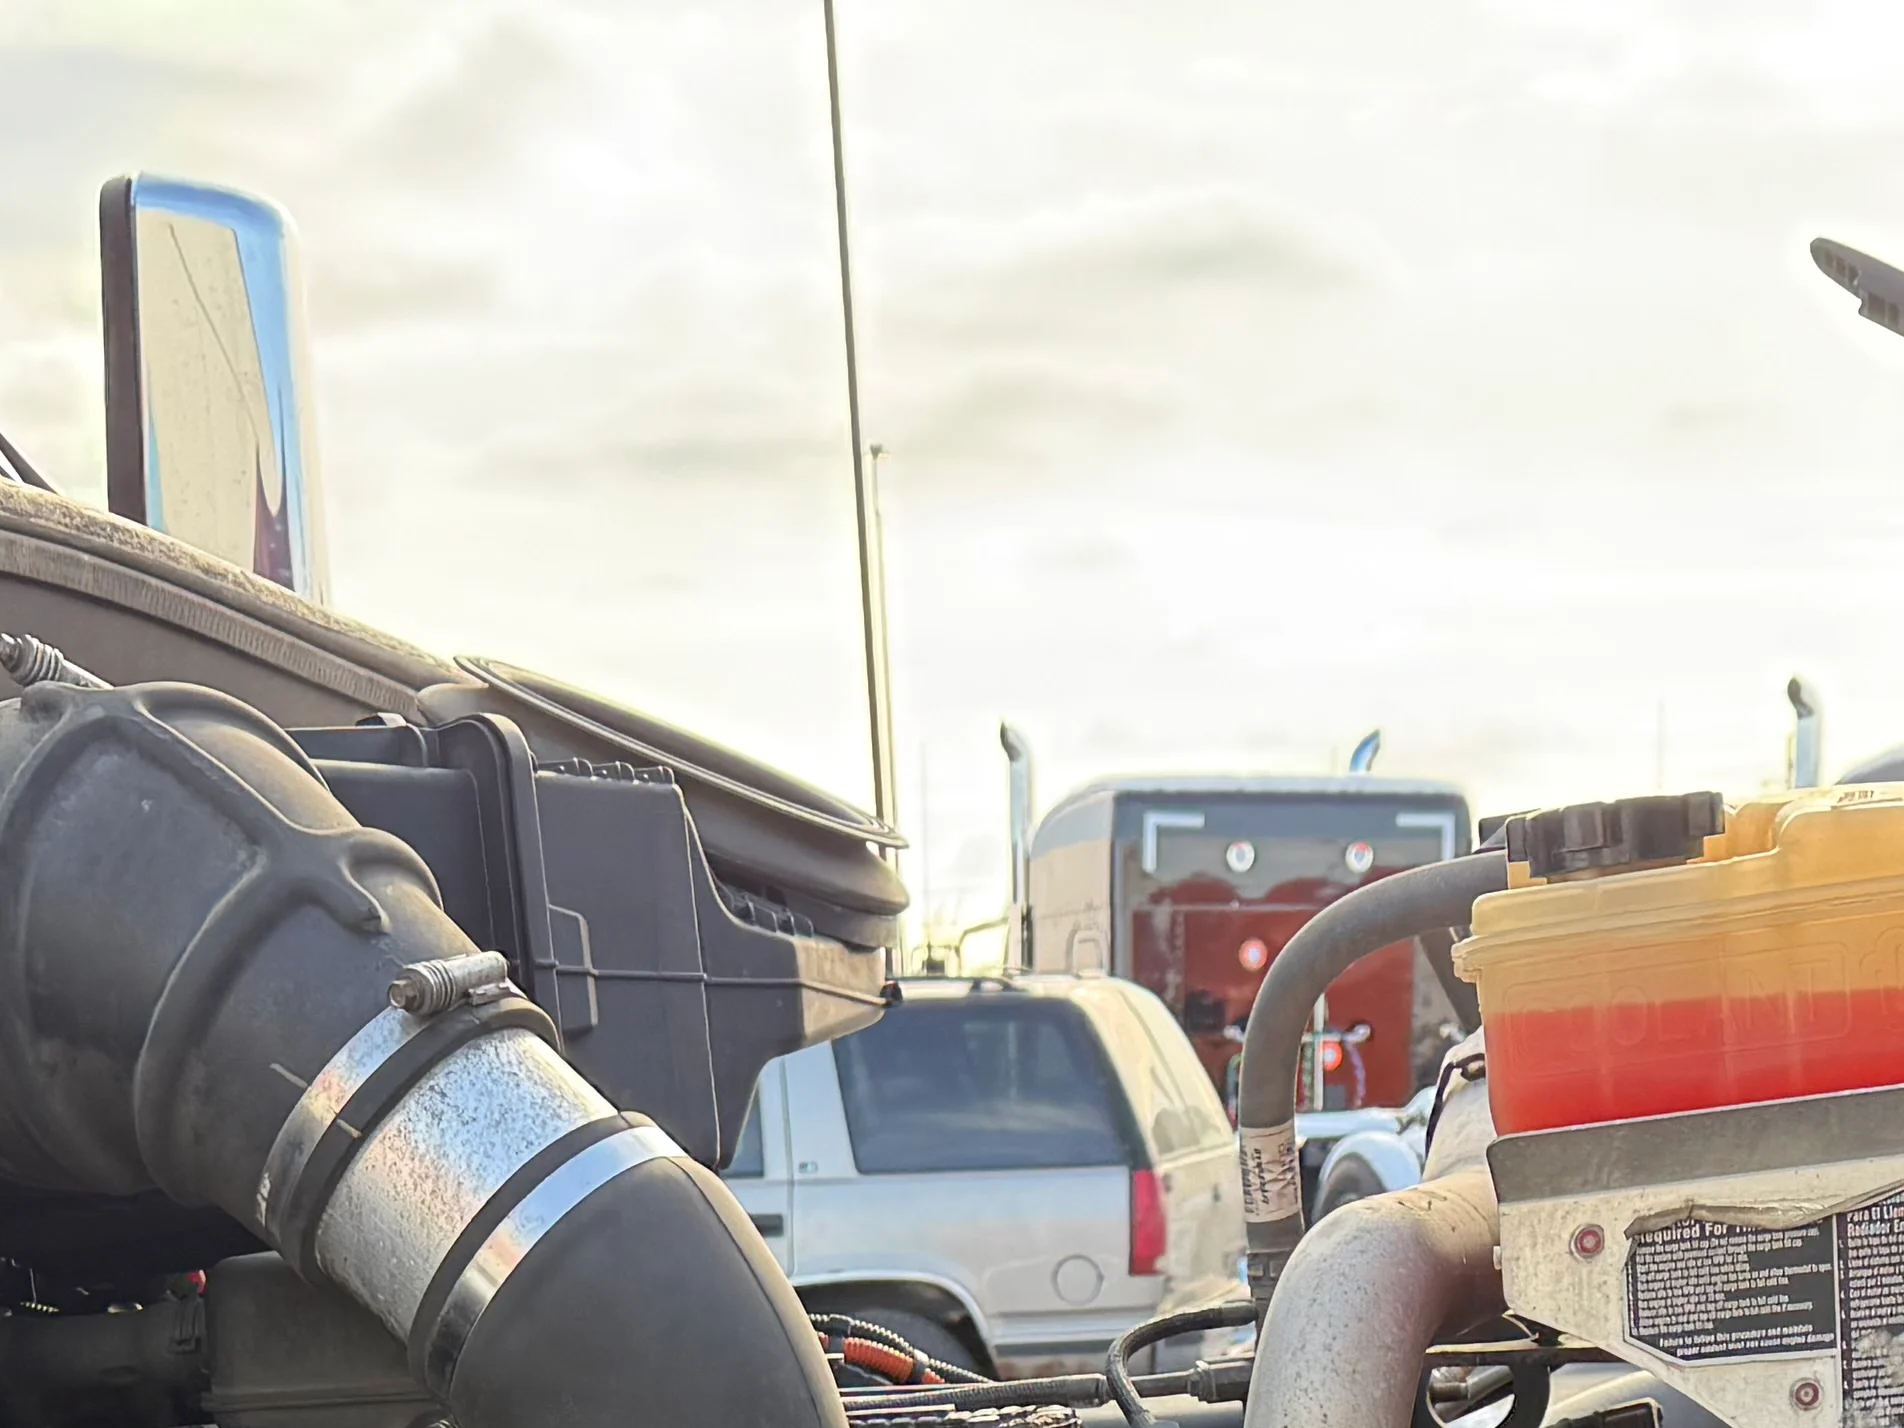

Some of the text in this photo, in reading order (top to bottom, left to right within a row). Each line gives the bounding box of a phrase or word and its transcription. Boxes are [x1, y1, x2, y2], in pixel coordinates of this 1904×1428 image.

[1848, 1210, 1869, 1222] Para
[1705, 1222, 1727, 1236] For
[1848, 1221, 1890, 1237] Radiador
